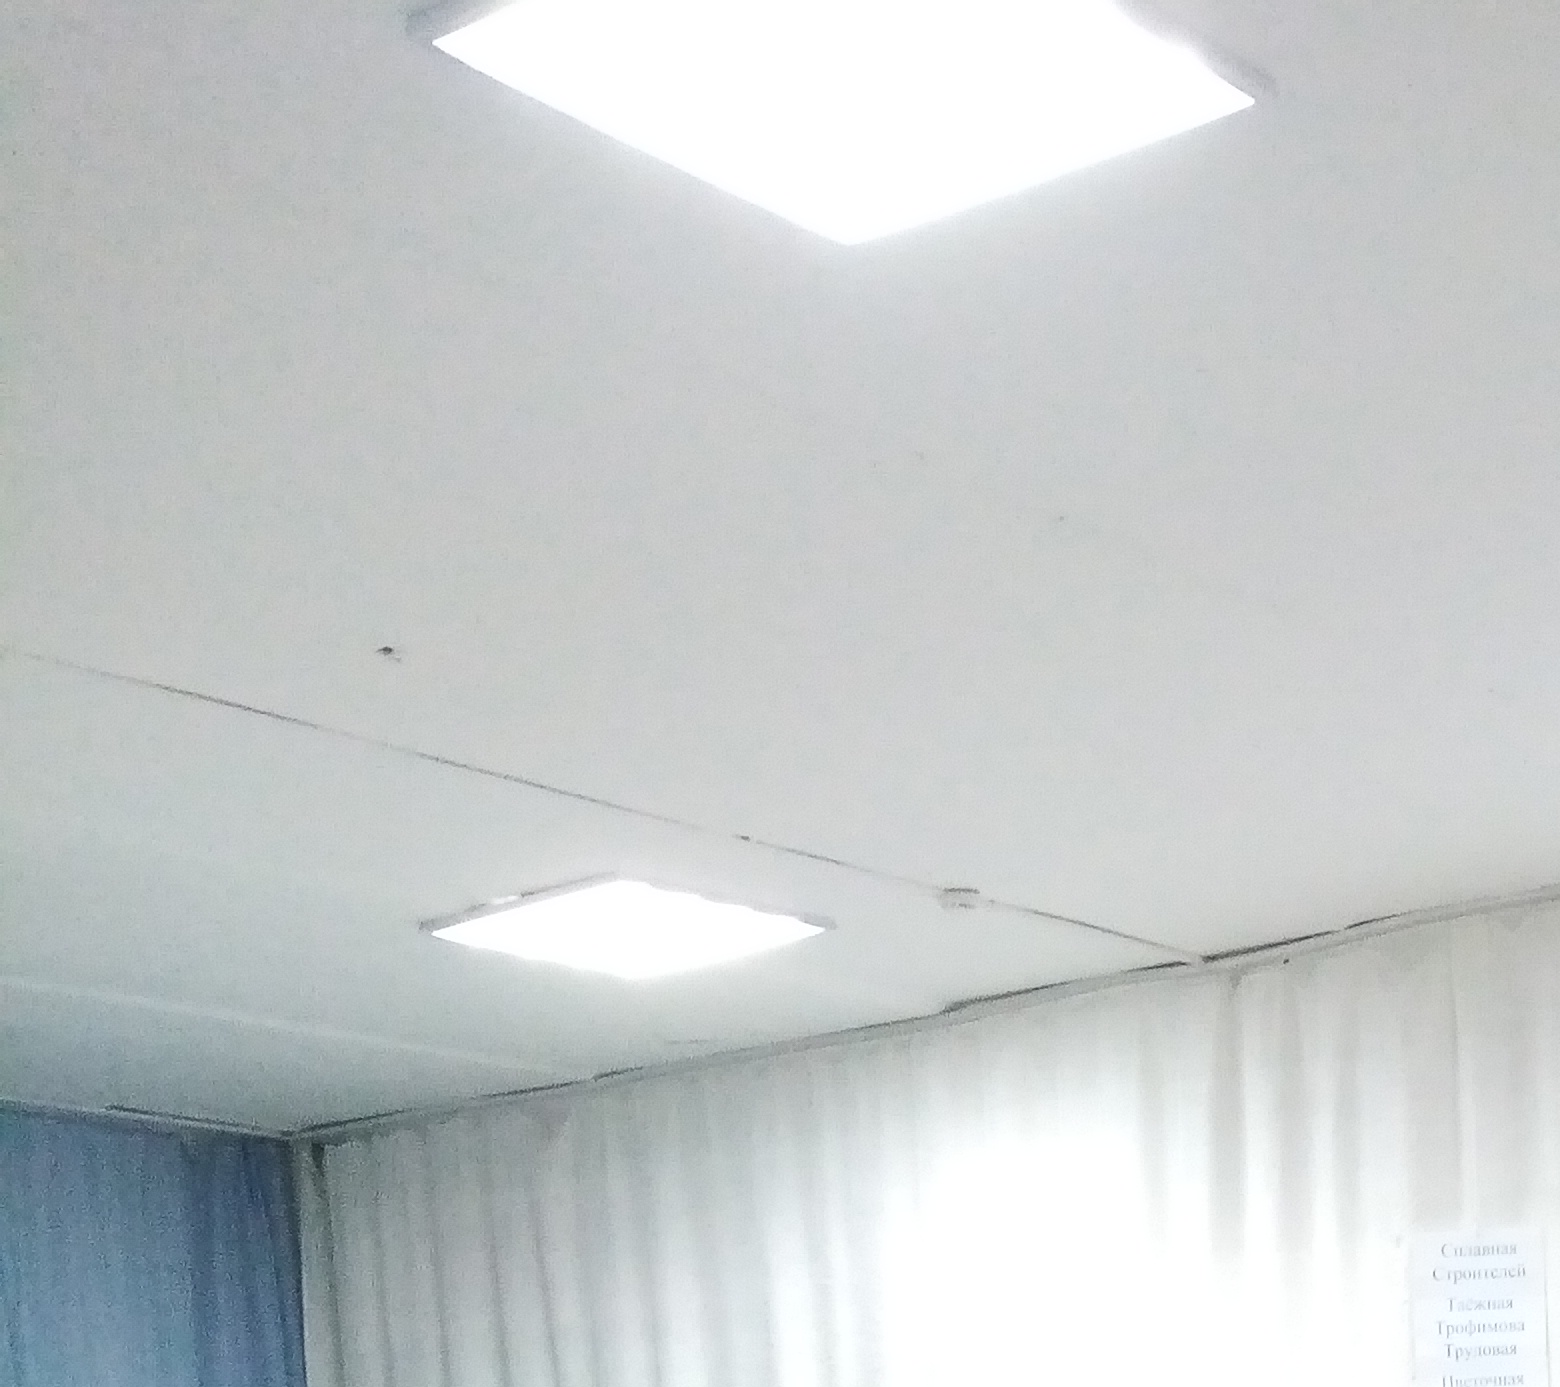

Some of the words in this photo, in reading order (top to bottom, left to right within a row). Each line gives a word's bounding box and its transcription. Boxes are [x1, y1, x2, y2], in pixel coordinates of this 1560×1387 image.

[1432, 1263, 1527, 1285] Строителей
[1436, 1319, 1526, 1339] Трофимова
[1444, 1343, 1518, 1361] Трудовая
